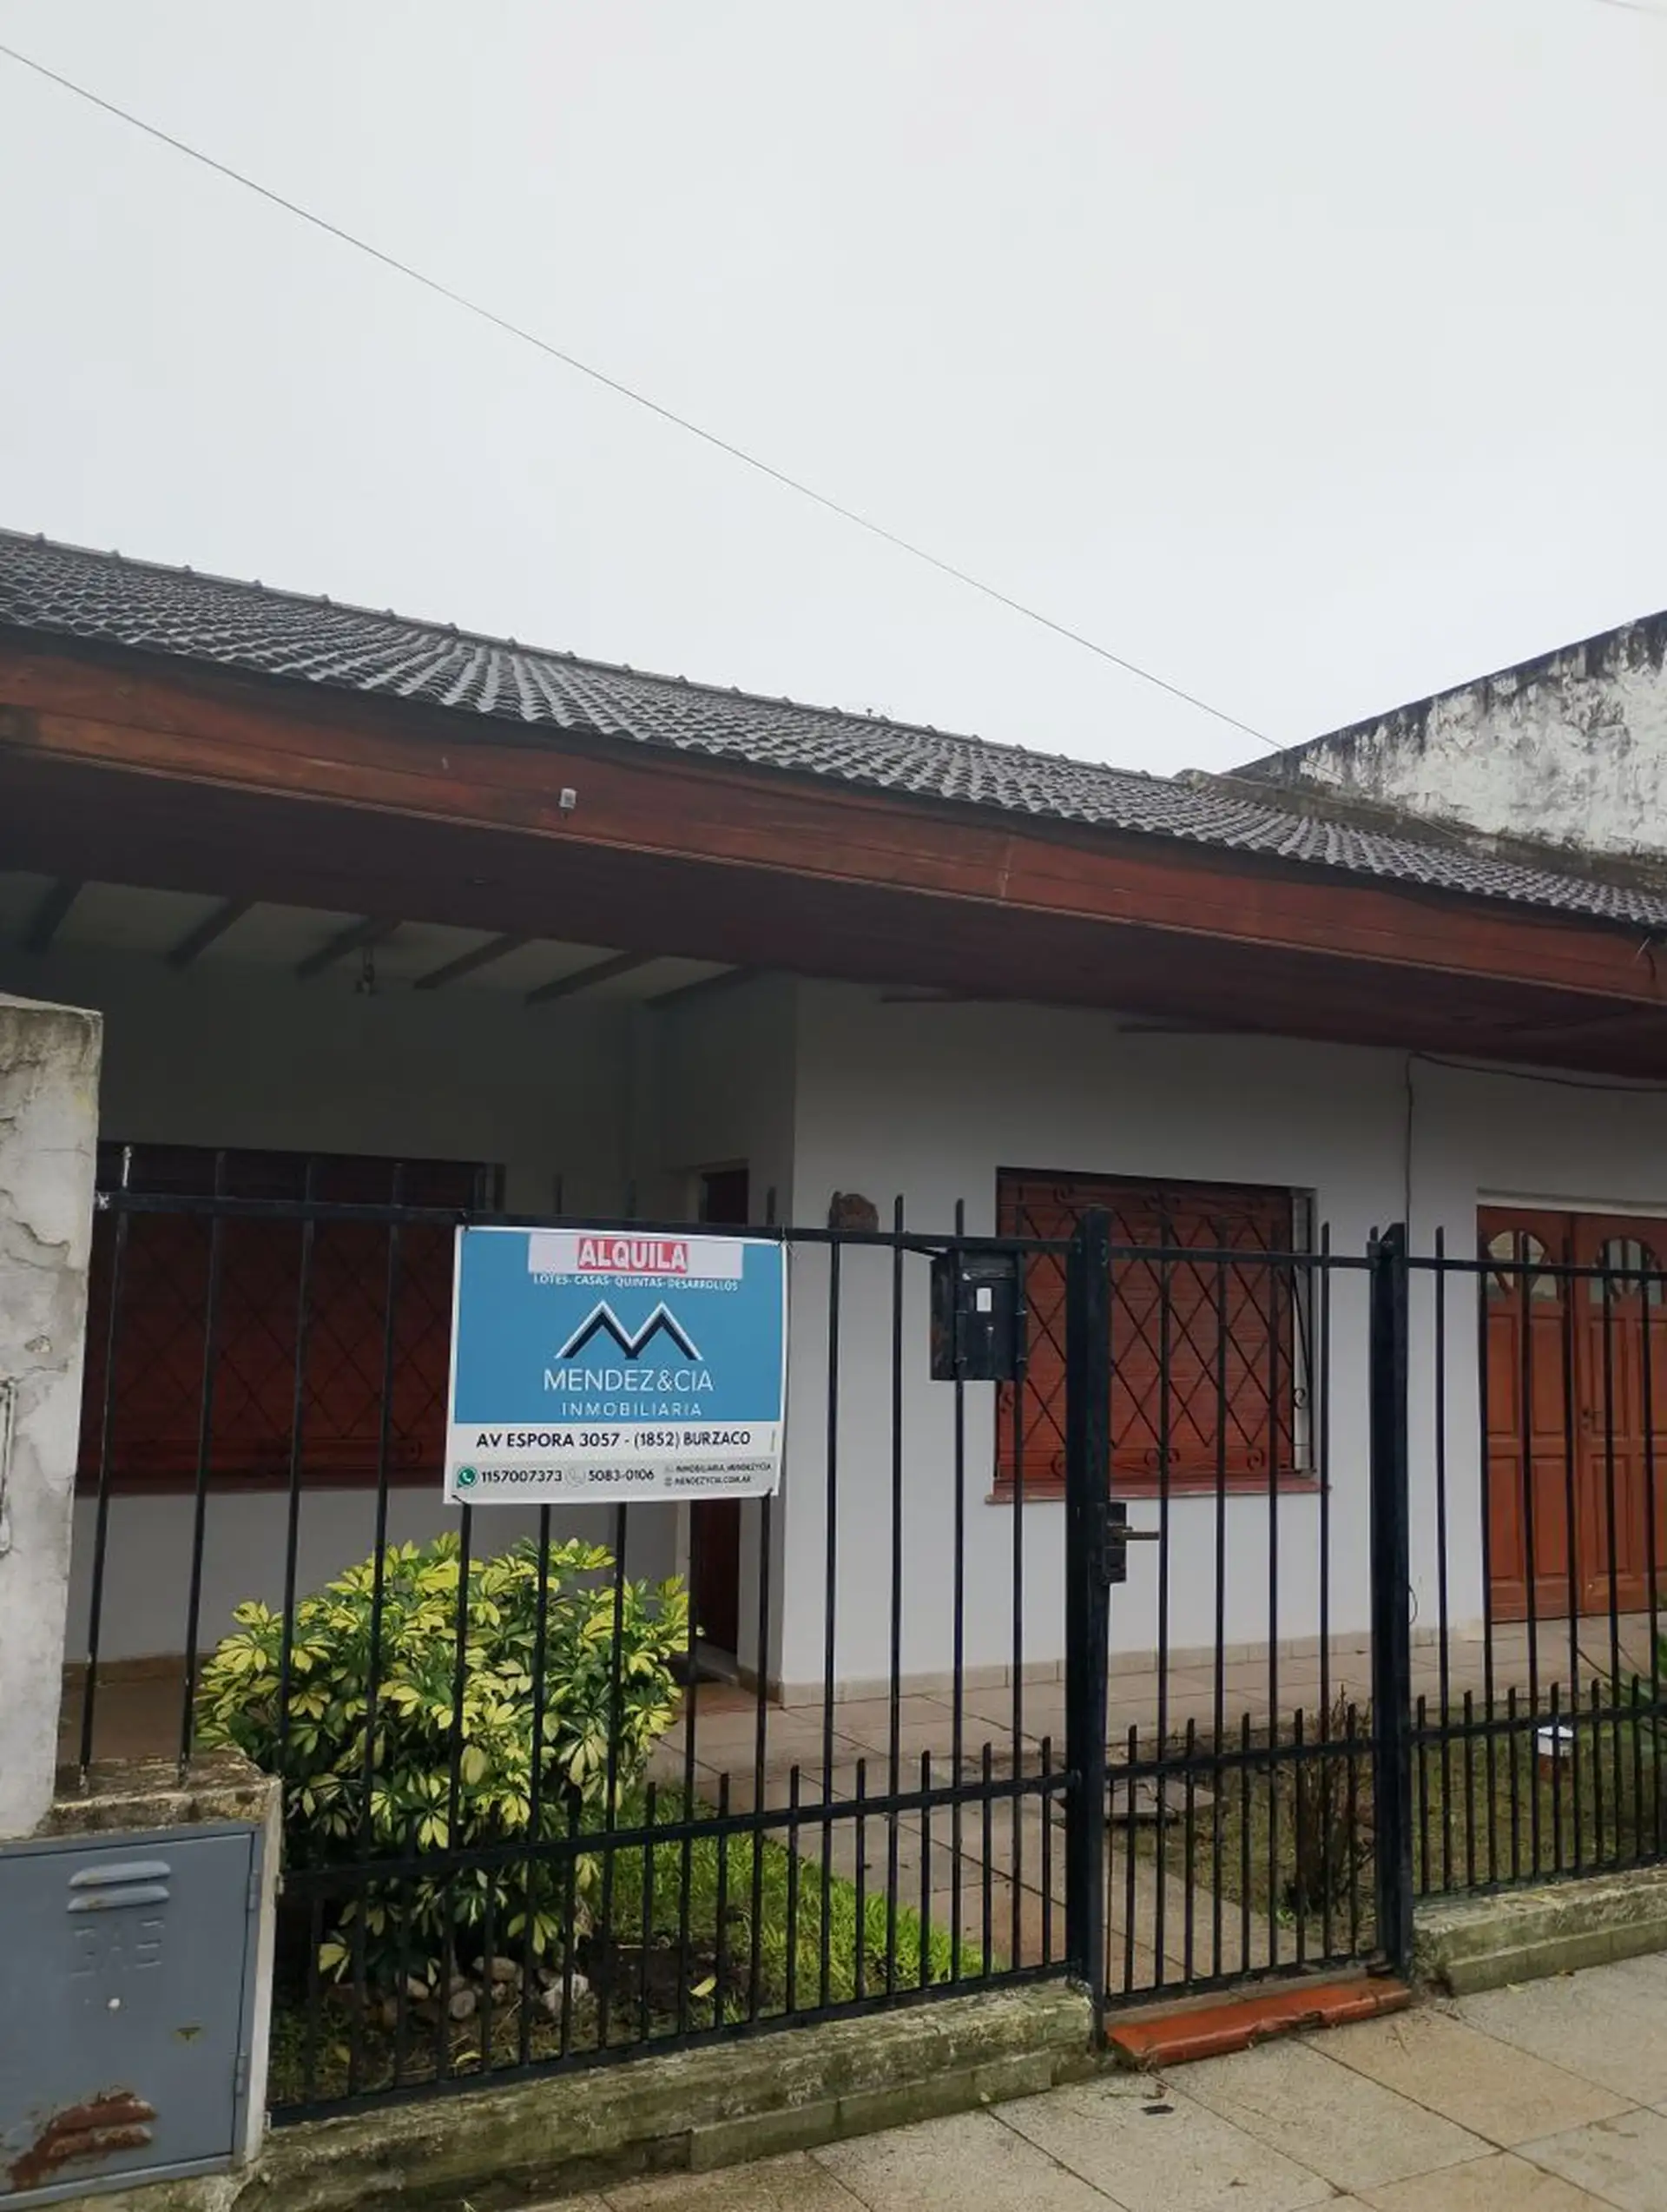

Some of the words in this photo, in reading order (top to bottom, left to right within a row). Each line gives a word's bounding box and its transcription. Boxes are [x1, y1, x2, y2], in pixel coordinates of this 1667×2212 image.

[579, 1239, 688, 1271] ALQUILA
[544, 1369, 714, 1391] MENDEZ&CIA
[562, 1402, 702, 1416] INMOBILIARIA
[476, 1433, 503, 1448] AV
[507, 1433, 574, 1448] ESPORA
[579, 1433, 621, 1447] 3057
[634, 1431, 681, 1450] (1852)
[683, 1431, 751, 1446] BURZACO
[481, 1470, 563, 1482] 1157007373
[588, 1469, 655, 1482] 5083-0106
